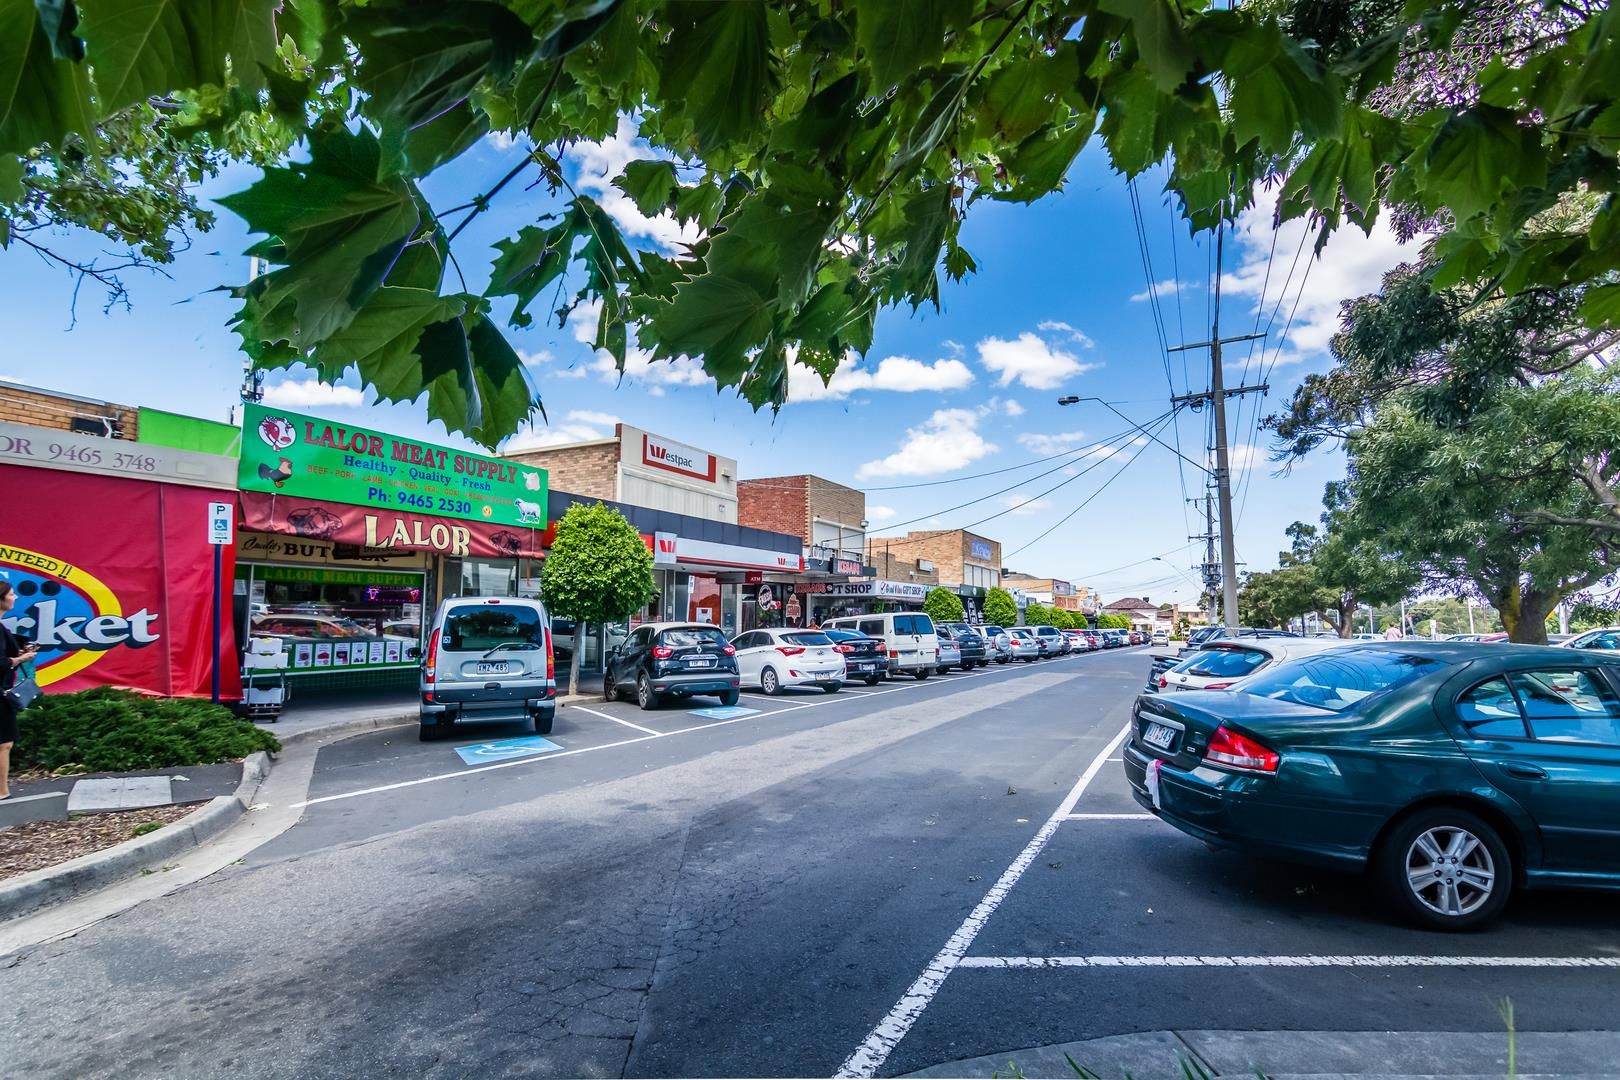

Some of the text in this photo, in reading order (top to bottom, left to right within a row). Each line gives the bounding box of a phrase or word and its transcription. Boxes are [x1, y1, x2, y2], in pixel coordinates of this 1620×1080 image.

[48, 443, 102, 465] 9465
[112, 452, 156, 472] 3748
[304, 422, 518, 484] LALOR MEAT SUPPLY
[650, 444, 693, 468] Westpac
[307, 465, 328, 475] BEEF
[344, 455, 491, 491] Healthy Quality Fresh
[217, 505, 226, 515] P
[368, 487, 392, 503] Ph:
[397, 491, 434, 509] 9465
[438, 498, 471, 514] 2530
[364, 514, 471, 557] LALOR
[264, 568, 416, 586] LALOR MEAT SUPPLY
[845, 584, 872, 595] SHOP
